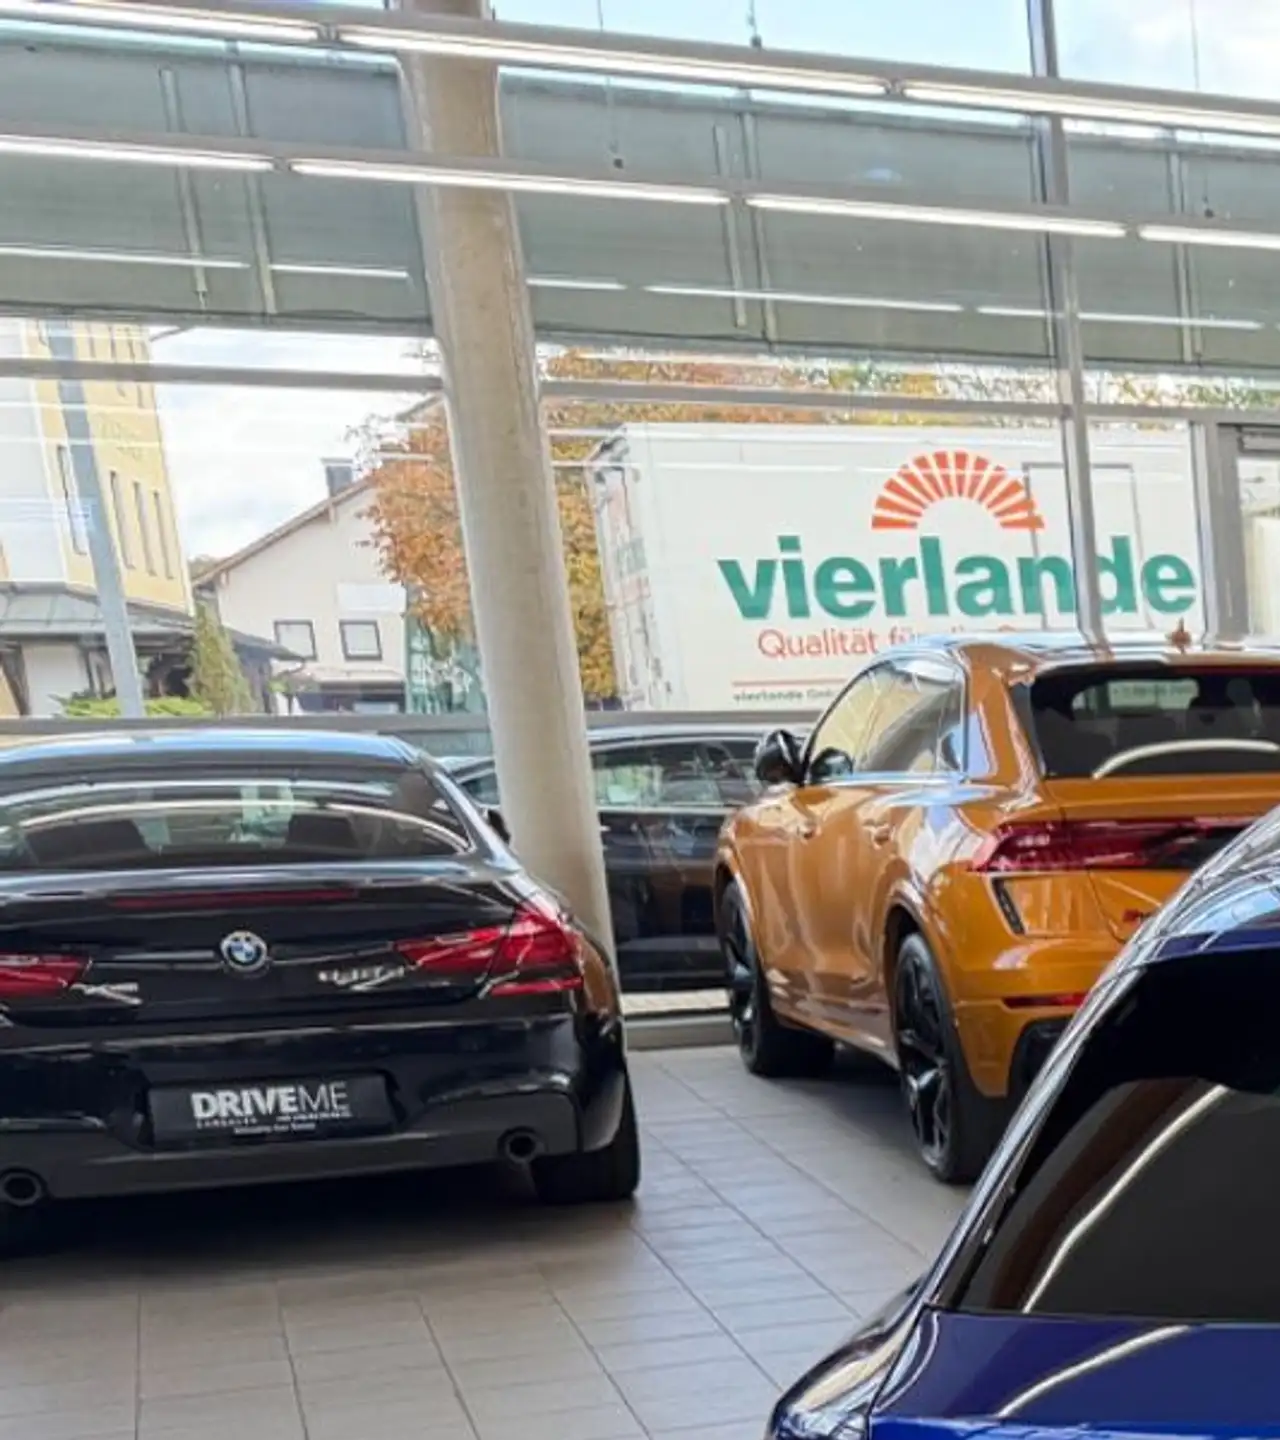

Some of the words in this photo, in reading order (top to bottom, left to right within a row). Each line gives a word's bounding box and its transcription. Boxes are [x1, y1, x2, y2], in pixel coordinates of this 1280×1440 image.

[717, 535, 1196, 619] vierlande
[758, 628, 878, 661] Qualität
[191, 1081, 349, 1119] DRIVEME
